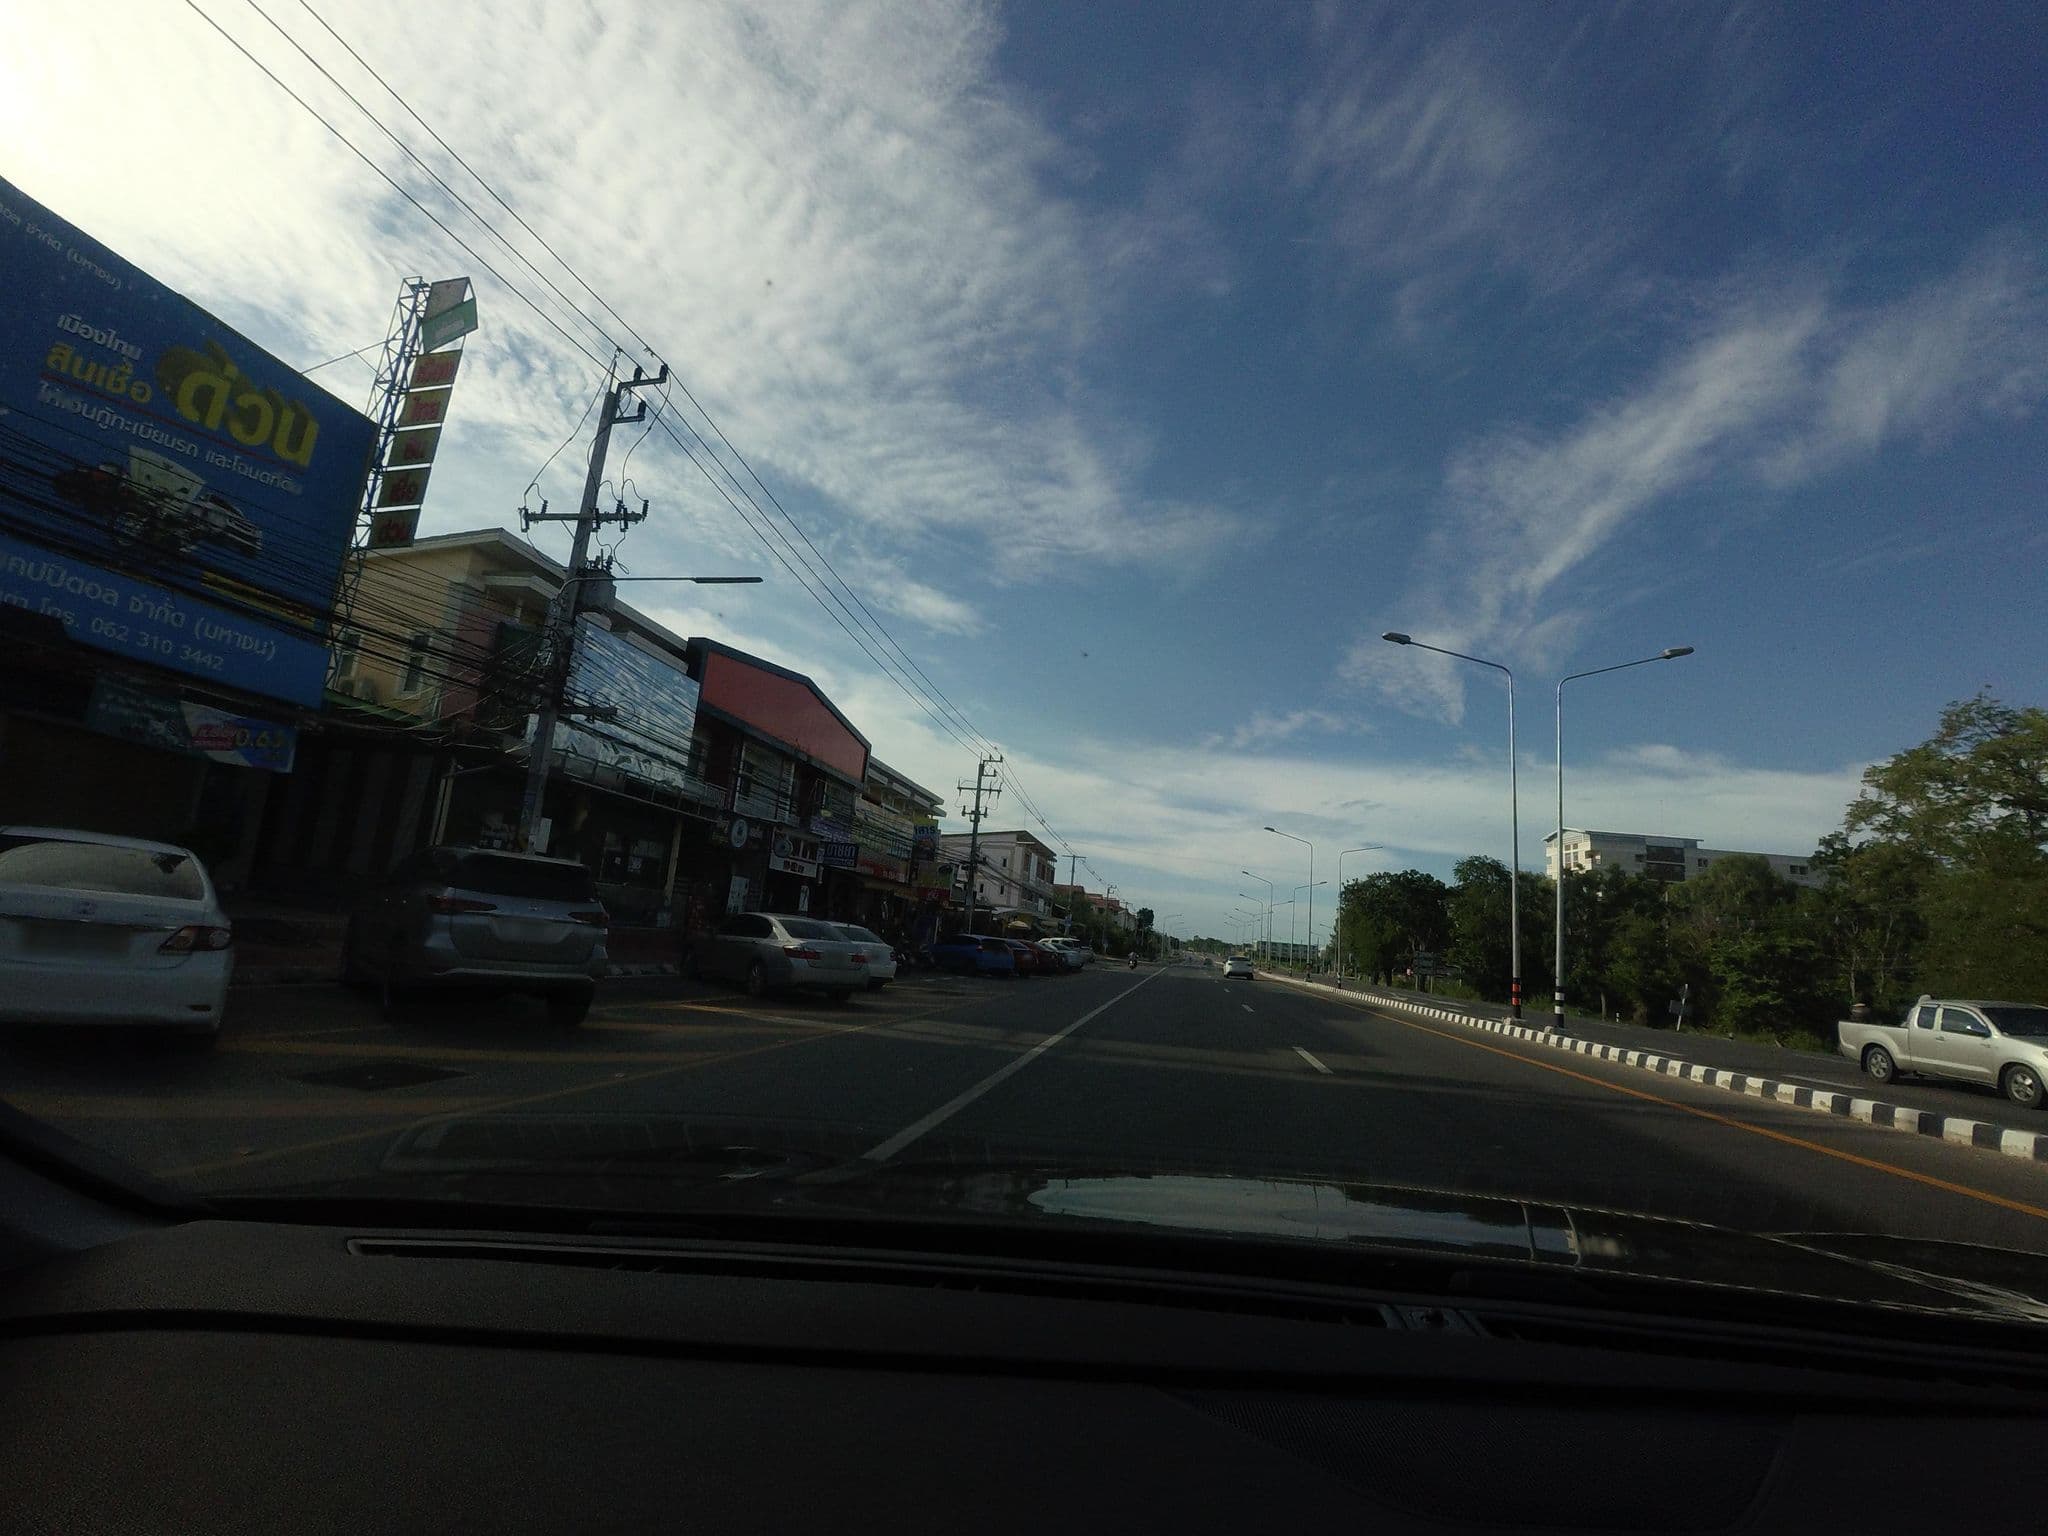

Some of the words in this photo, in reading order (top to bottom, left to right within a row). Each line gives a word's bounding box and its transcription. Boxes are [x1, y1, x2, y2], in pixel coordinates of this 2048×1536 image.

[57, 312, 142, 361] เมืองไทย
[46, 341, 153, 404] สินเชื่อ
[174, 353, 320, 469] ด่วน
[129, 590, 186, 630] จำกัด
[194, 616, 276, 662] (มหาชน)
